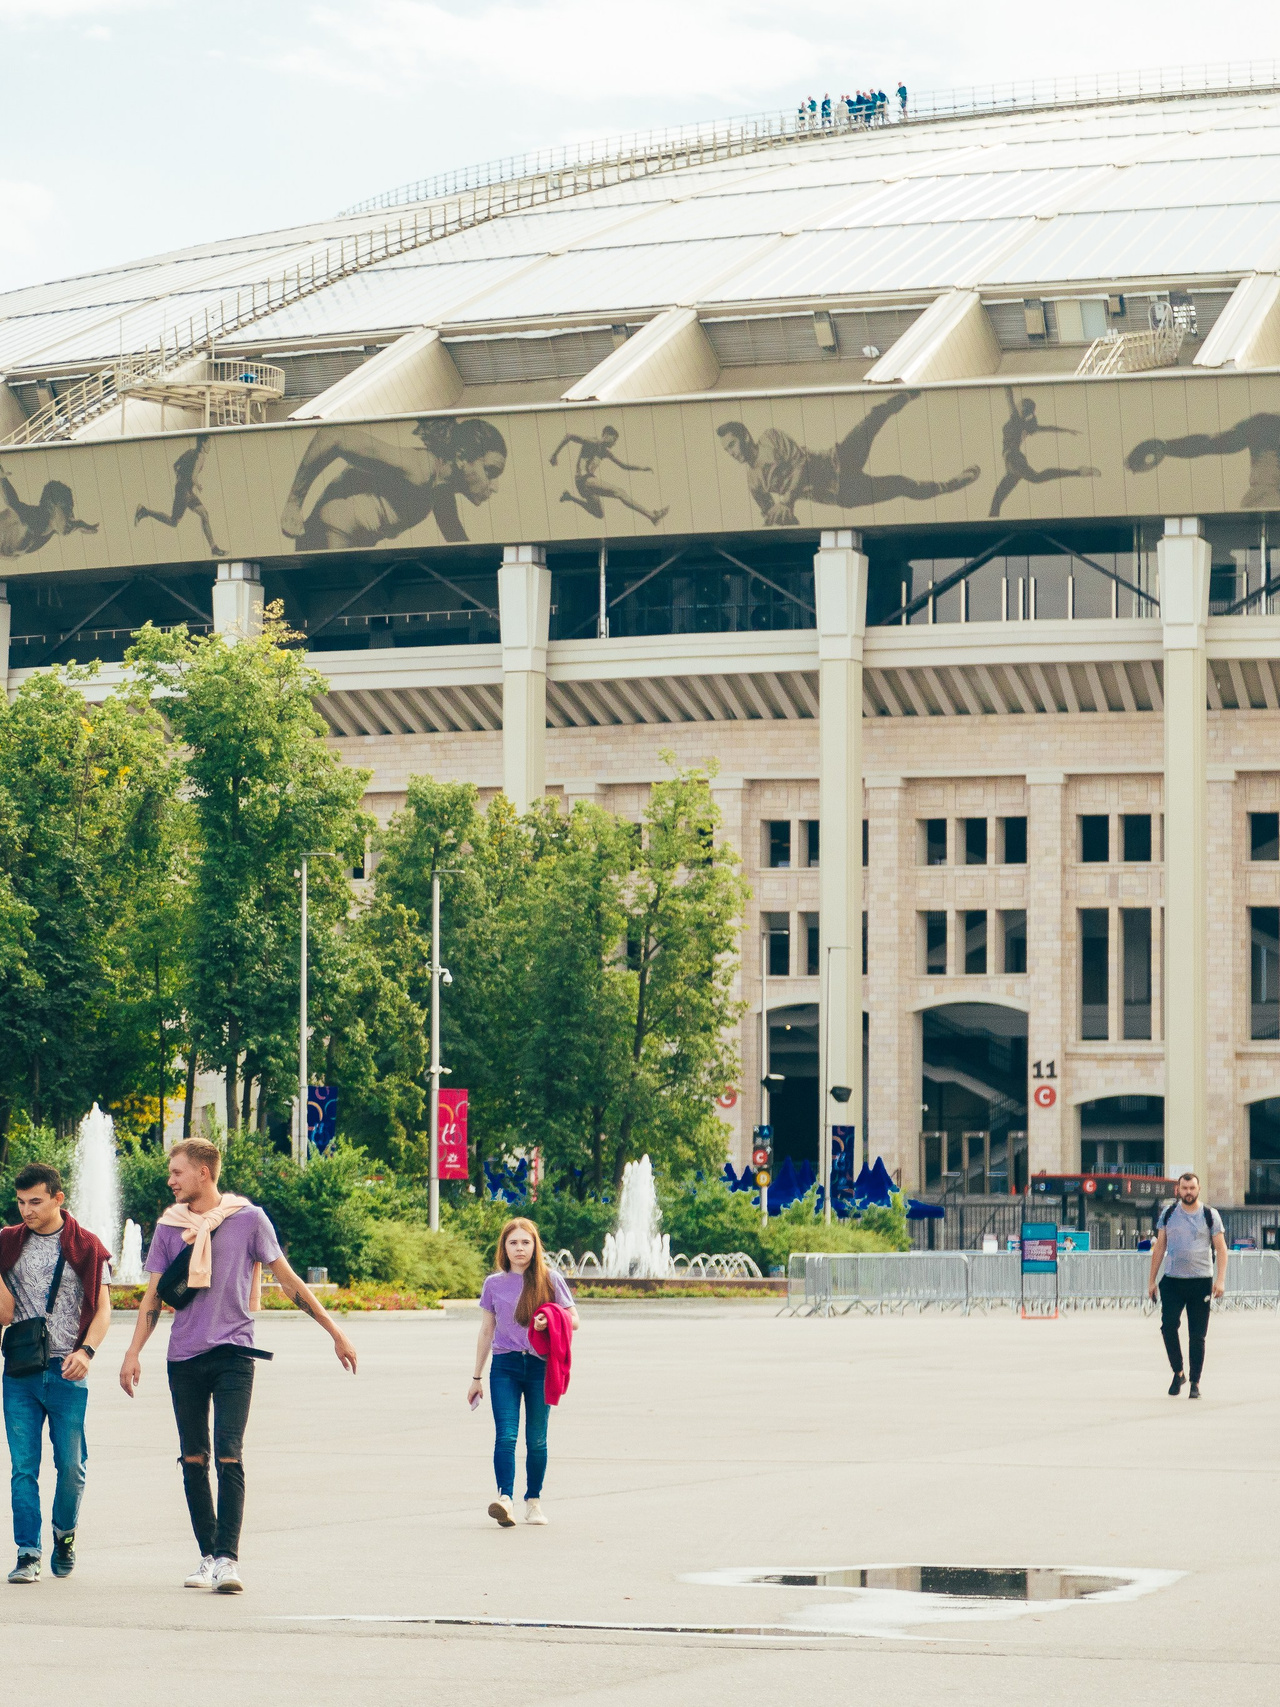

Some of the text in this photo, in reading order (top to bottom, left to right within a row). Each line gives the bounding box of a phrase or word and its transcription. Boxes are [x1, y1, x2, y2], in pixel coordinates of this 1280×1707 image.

[1033, 1060, 1057, 1078] 11
[1039, 1088, 1051, 1105] C
[756, 1152, 765, 1164] C
